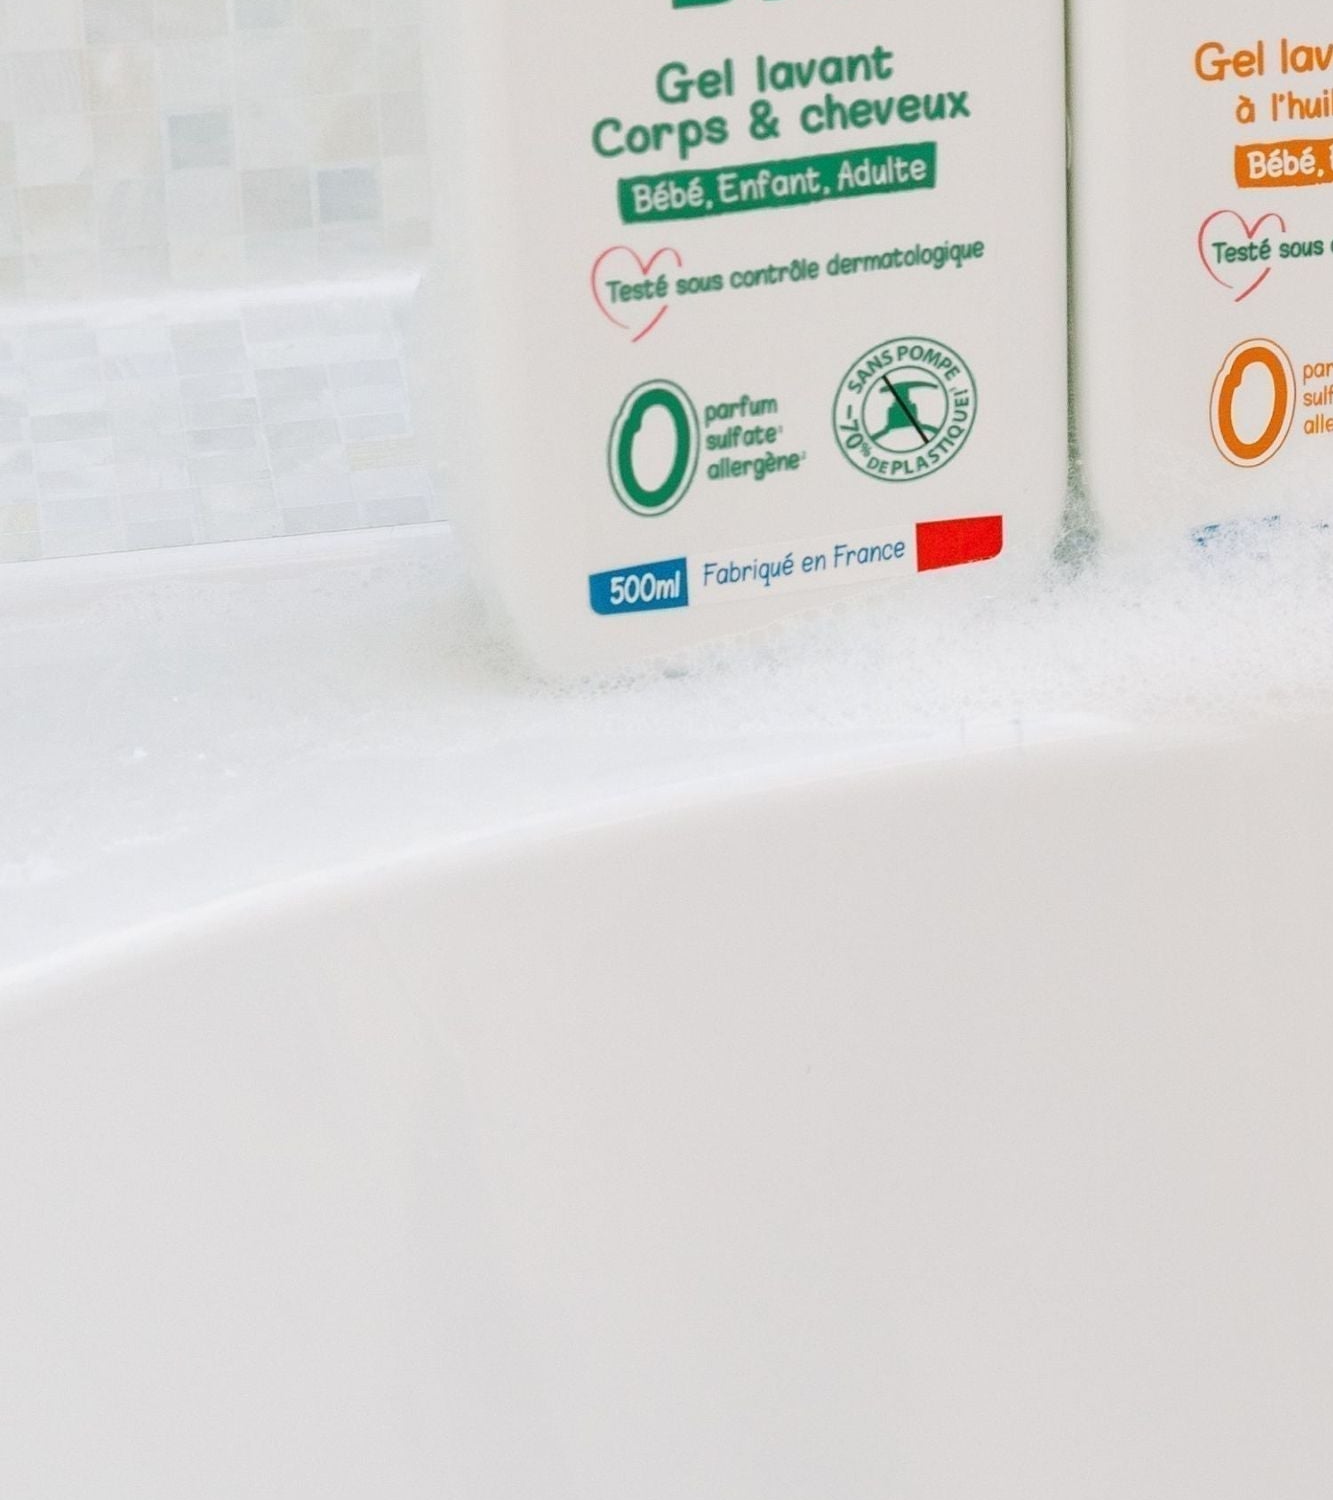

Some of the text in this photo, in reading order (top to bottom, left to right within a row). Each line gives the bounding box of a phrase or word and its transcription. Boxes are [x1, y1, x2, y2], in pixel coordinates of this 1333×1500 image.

[656, 45, 893, 104] Gel lavant
[1195, 40, 1264, 82] Gel
[592, 89, 971, 160] Corps & cheveux
[1236, 95, 1256, 123] à
[632, 155, 927, 215] Bébé, Enfant, Adulte
[1246, 145, 1324, 180] Bébé,
[605, 239, 985, 304] Testé sous contrôle dermatologique
[1211, 238, 1272, 265] Testé
[1278, 238, 1324, 259] sous
[848, 345, 961, 395] SANS POMPE
[704, 394, 778, 428] parfum
[609, 538, 906, 607] 500ml Fabriqué en France
